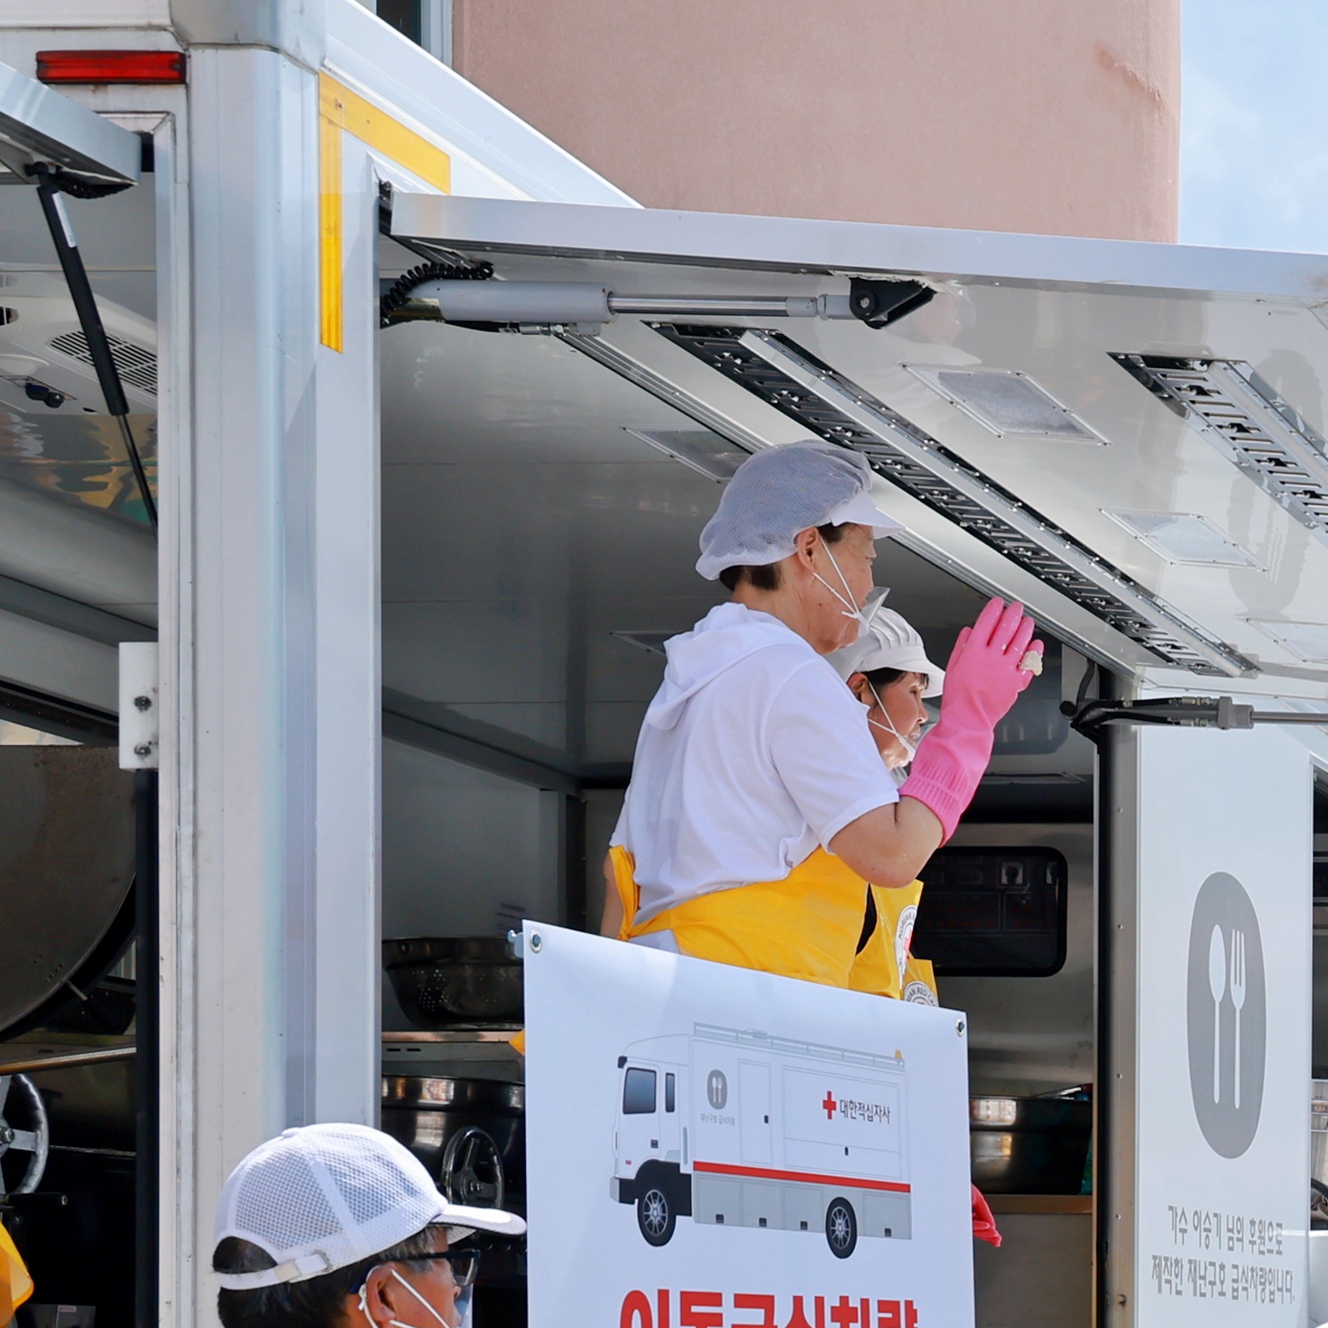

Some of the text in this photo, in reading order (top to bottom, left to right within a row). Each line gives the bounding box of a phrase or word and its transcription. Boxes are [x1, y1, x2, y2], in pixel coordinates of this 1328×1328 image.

[840, 1100, 890, 1124] 대한적십자사
[1168, 1205, 1283, 1255] 가수 이승기 님의 후원으로
[1152, 1255, 1295, 1304] 제작한 재난구호 급식차량입니다.
